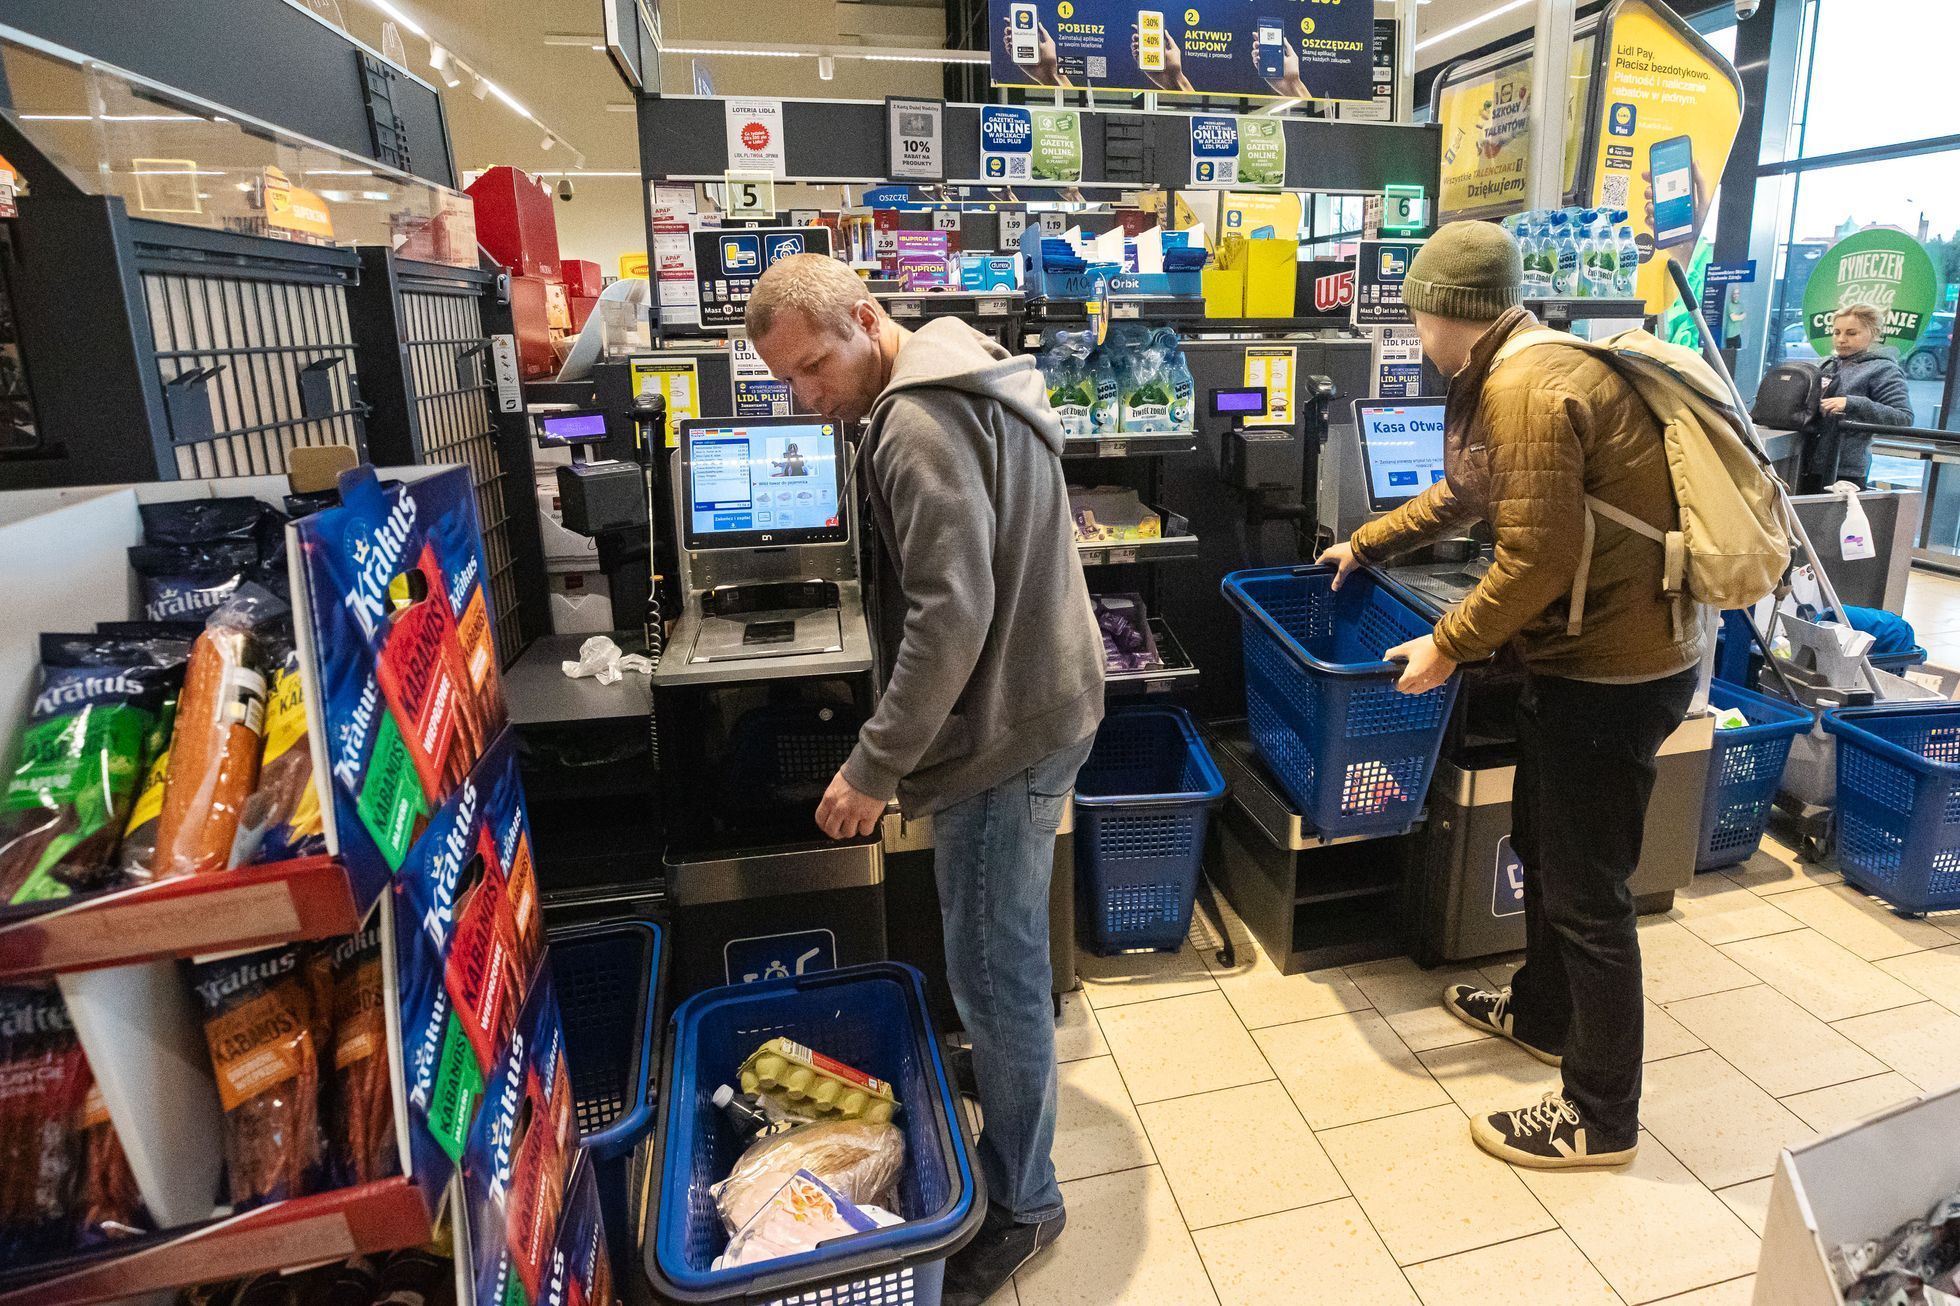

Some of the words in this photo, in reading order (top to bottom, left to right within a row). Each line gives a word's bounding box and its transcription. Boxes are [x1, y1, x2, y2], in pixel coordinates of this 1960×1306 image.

[1062, 5, 1070, 14] 1.
[1144, 18, 1158, 27] -30%
[1188, 13, 1196, 22] 2.
[1058, 23, 1105, 35] POBIERZ
[1304, 21, 1312, 30] 3.
[1144, 36, 1159, 46] -40%
[1185, 30, 1232, 42] AKTYWUJ
[1185, 42, 1227, 51] KUPONY
[1302, 38, 1363, 51] OSZCZĘDZAJ!
[1144, 54, 1160, 63] -50%
[1618, 45, 1634, 55] Lidl
[1637, 48, 1654, 61] Pay.
[1616, 58, 1648, 72] Płacisz
[1652, 63, 1710, 80] bezdotykowo.
[1614, 72, 1654, 86] Płatność
[1662, 79, 1706, 93] naliczanie
[1612, 87, 1649, 99] rabatów
[1652, 92, 1660, 100] w
[1492, 102, 1520, 119] SZKOŁY
[984, 122, 1030, 134] ONLINE
[1485, 118, 1526, 138] TALENTÓW
[1194, 130, 1237, 140] ONLINE
[903, 140, 930, 153] 10%
[1040, 139, 1074, 148] GAZETKĘ
[1247, 144, 1278, 152] GAZETKĘ
[1248, 152, 1278, 160] ONLINE,
[743, 184, 757, 206] 5
[879, 194, 908, 202] OSZCZĘ
[1398, 198, 1410, 217] 6
[940, 219, 956, 228] 1.79
[1006, 220, 1020, 229] 1.99
[1046, 221, 1061, 230] 1.19
[878, 240, 894, 248] 2.99
[1006, 238, 1020, 247] 1.99
[1838, 252, 1904, 282] RYNECZEK
[1111, 278, 1139, 289] Orbit
[1315, 271, 1356, 311] W5
[737, 394, 760, 402] LIDL
[761, 394, 788, 402] PLUS!
[1070, 407, 1088, 416] ZDRÓJ
[1150, 406, 1166, 416] ZDRÓJ
[1374, 422, 1406, 433] Kasa
[1410, 420, 1444, 432] Otwa
[345, 486, 416, 641] Krakus
[449, 555, 478, 618] Krakus
[145, 590, 233, 621] Krakus
[399, 592, 449, 725] KABANOSY
[32, 676, 144, 717] Krakus
[334, 673, 378, 790] Krakus
[501, 806, 522, 881] Krakus
[424, 777, 477, 954] Krakus
[462, 866, 500, 1009] KABANOSY
[481, 940, 502, 1030] WIEPRZOWE
[410, 984, 446, 1111] Krakus
[489, 1028, 524, 1212] Krakus
